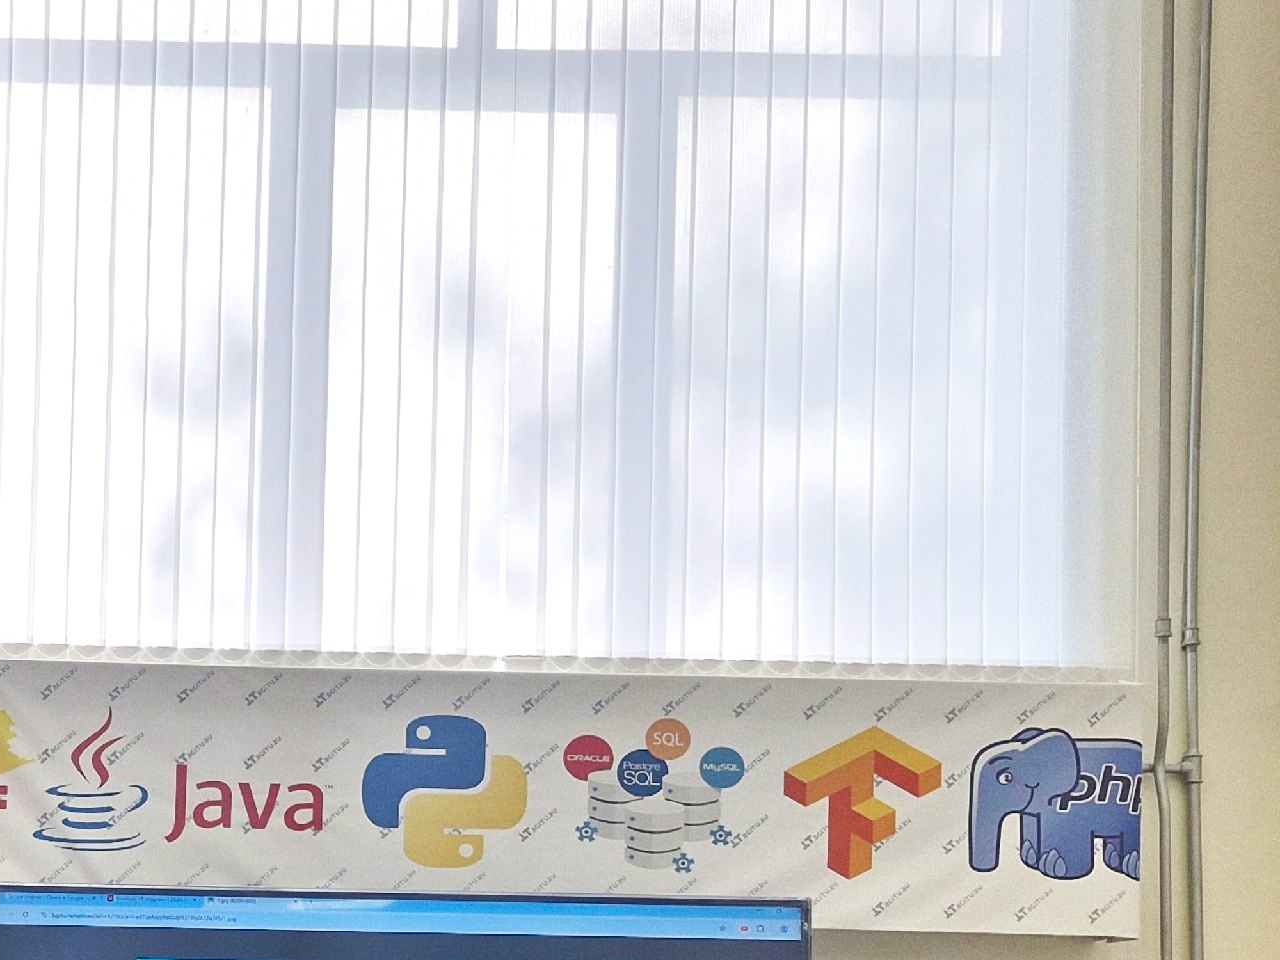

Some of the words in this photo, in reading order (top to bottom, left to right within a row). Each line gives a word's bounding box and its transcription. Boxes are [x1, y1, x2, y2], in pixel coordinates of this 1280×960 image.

[653, 732, 684, 747] SQL
[567, 754, 611, 763] ORACLE
[623, 761, 660, 772] Postgre
[703, 763, 741, 773] MySQL
[623, 771, 660, 786] SQL
[164, 764, 324, 843] Java
